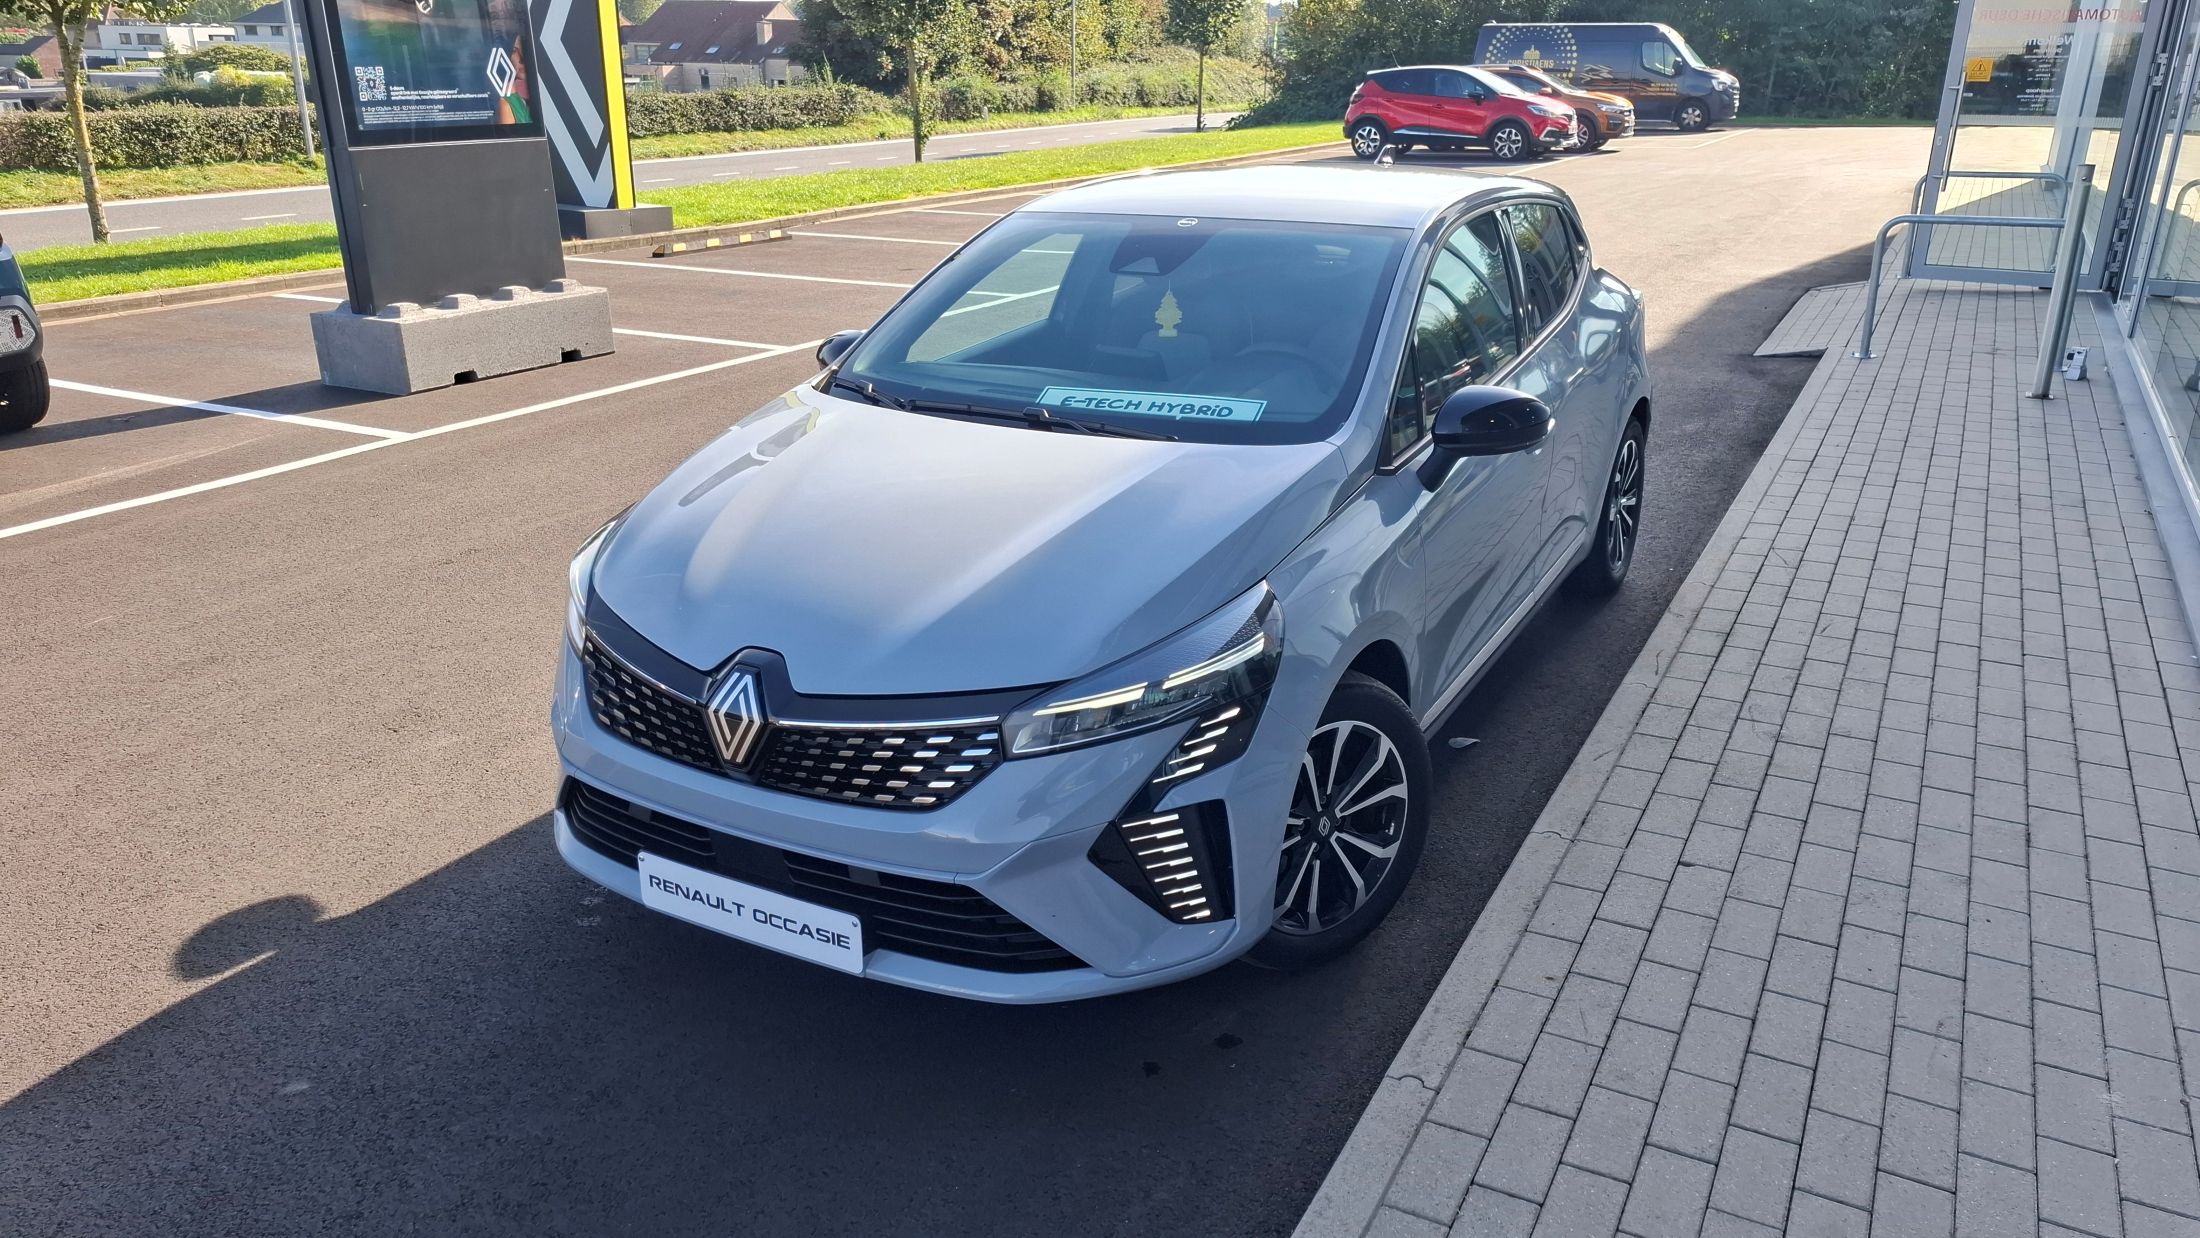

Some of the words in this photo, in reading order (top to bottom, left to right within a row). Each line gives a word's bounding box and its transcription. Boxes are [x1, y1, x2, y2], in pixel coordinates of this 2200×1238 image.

[1060, 396, 1143, 411] E-TECH
[648, 873, 745, 917] RENAULT
[752, 908, 851, 950] OCCASIE
